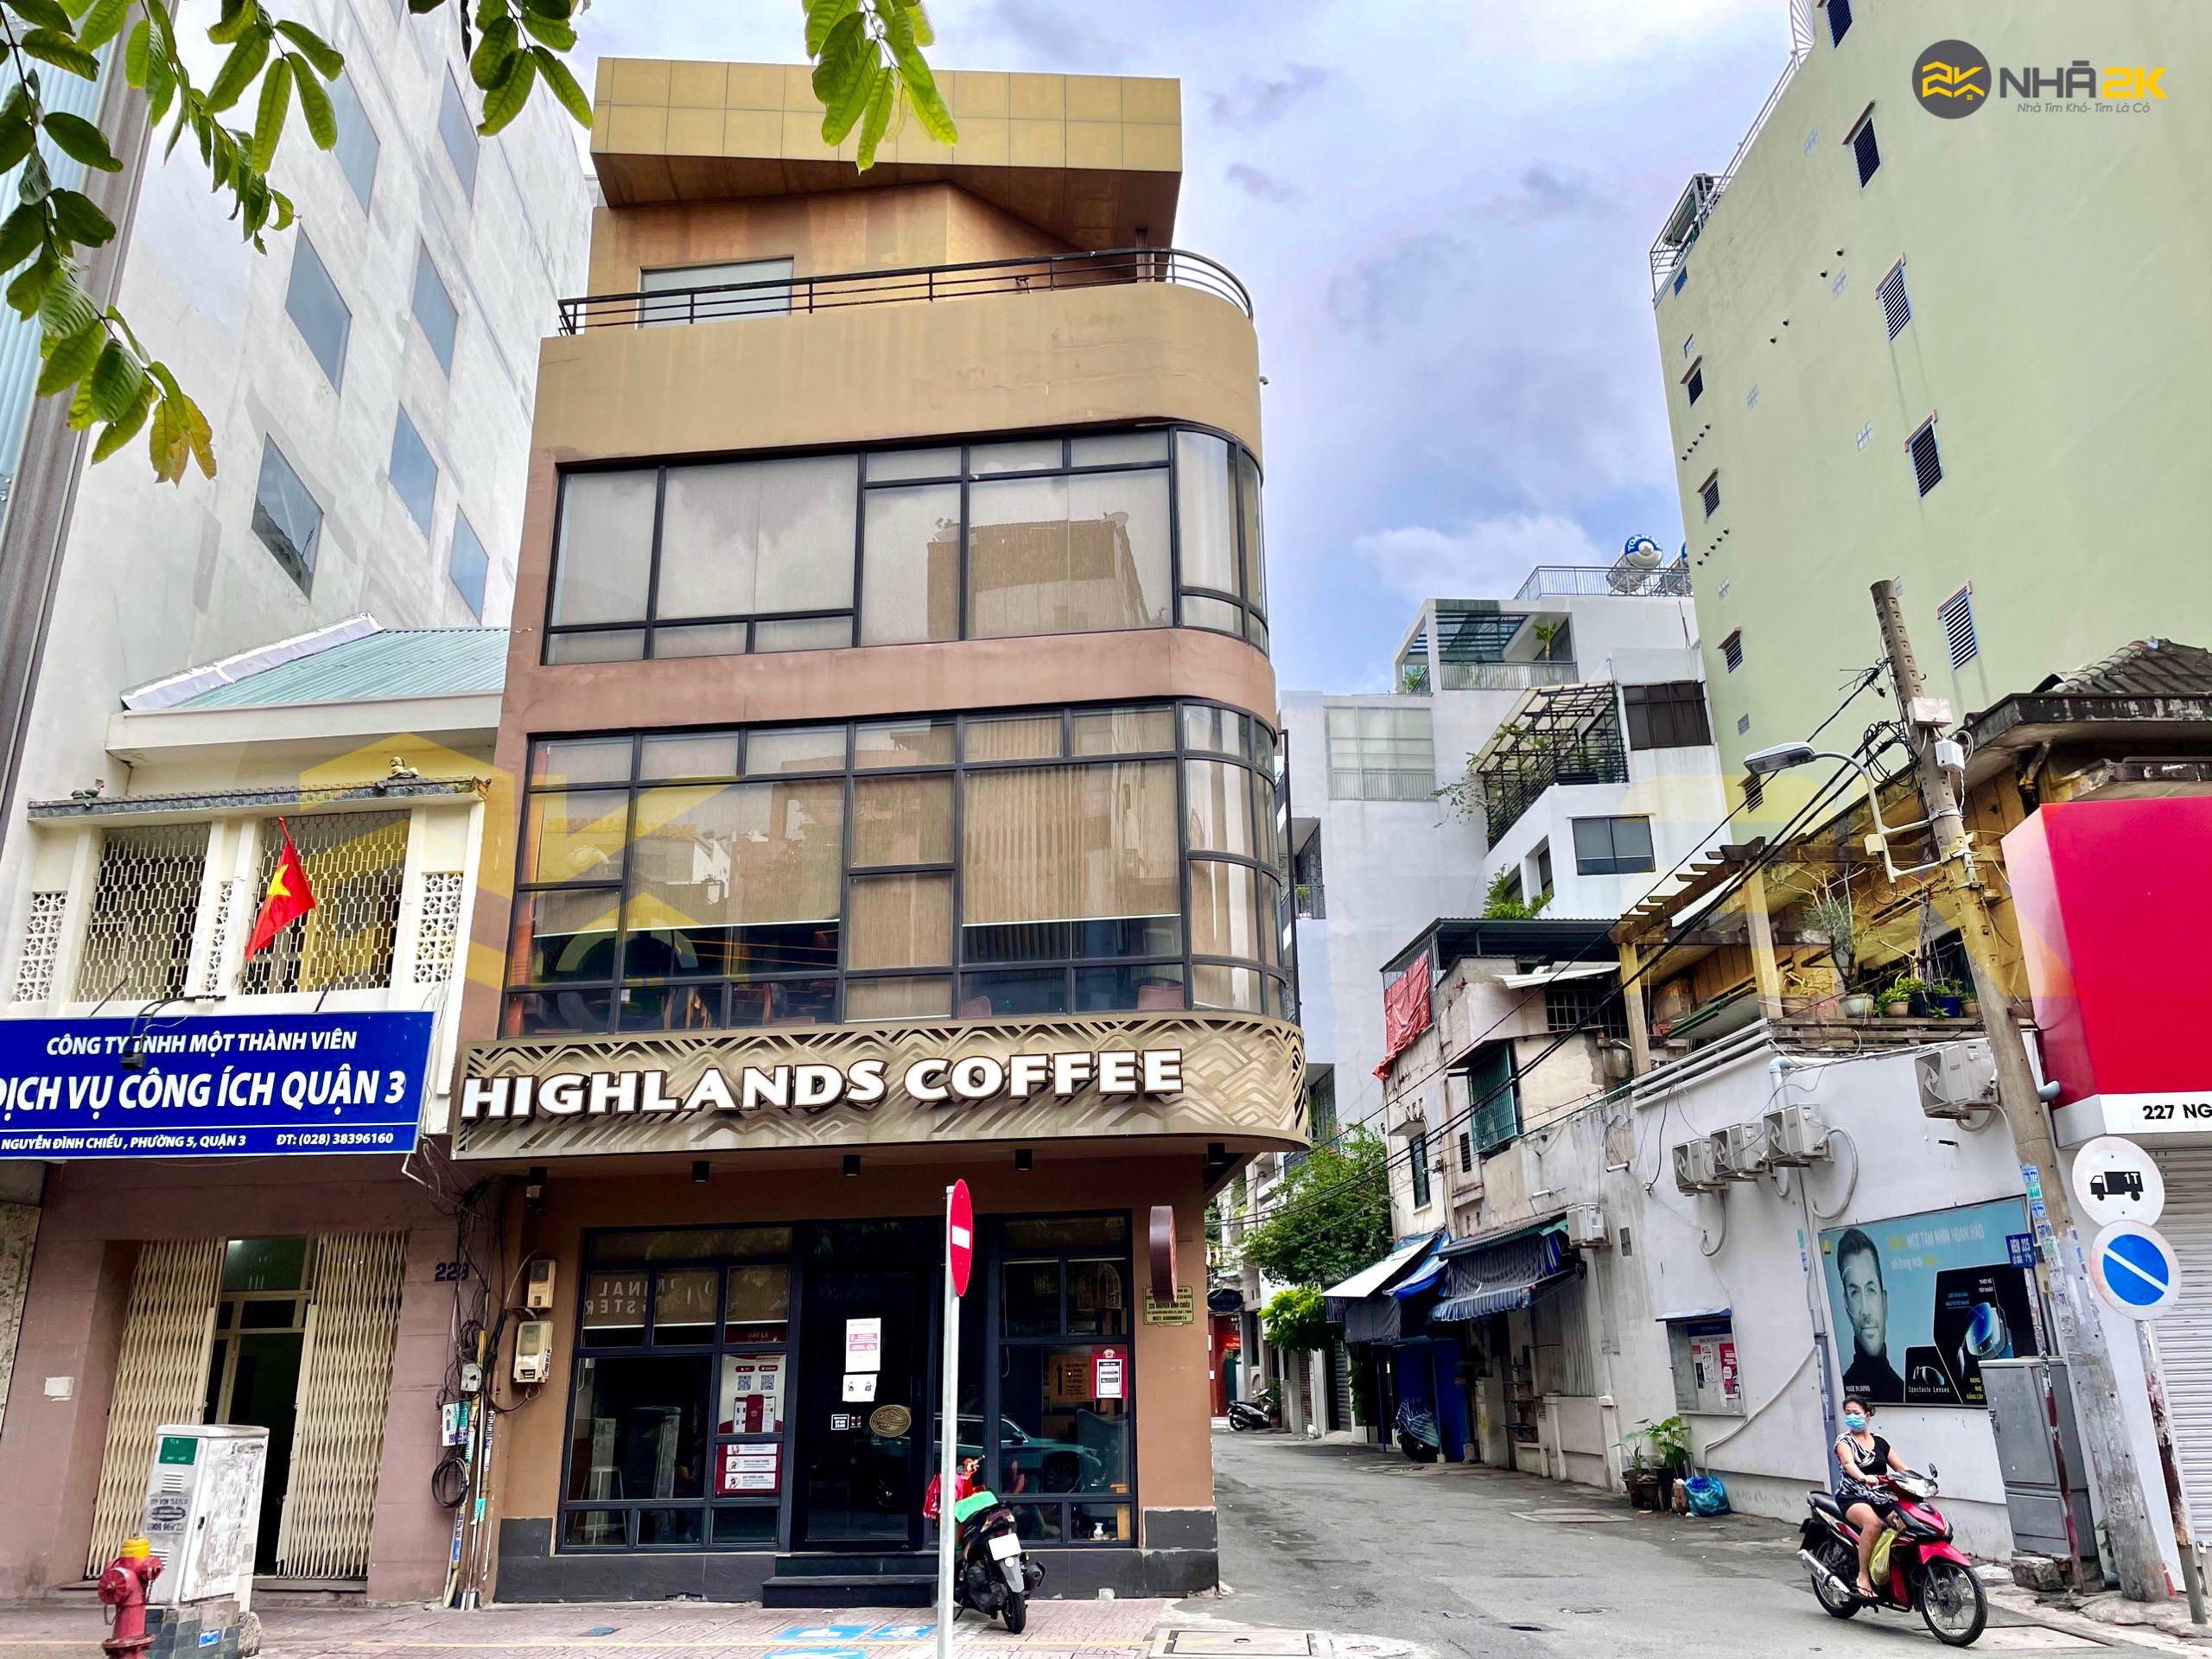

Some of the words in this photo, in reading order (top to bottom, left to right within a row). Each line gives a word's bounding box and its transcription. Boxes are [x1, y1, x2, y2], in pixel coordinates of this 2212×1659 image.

[47, 1033, 101, 1055] CÔNG
[105, 1036, 129, 1054] TY
[132, 1035, 187, 1053] TNHH
[189, 1030, 235, 1058] MỘT
[238, 1030, 309, 1052] THÀNH
[310, 1027, 357, 1049] VIÊN
[68, 1076, 113, 1120] VỤ
[118, 1068, 212, 1109] CÔNG
[217, 1065, 276, 1107] ÍCH
[282, 1063, 378, 1116] QUẬN
[385, 1071, 405, 1103] 3
[460, 1060, 885, 1121] HIGHLANDS
[904, 1049, 1185, 1103] COFFEE
[2143, 1105, 2174, 1120] 227
[1, 1135, 51, 1149] NGUYỄN
[53, 1136, 85, 1149] ĐÌNH
[130, 1135, 184, 1147] PHƯỜNG
[186, 1136, 197, 1148] 5,
[200, 1134, 236, 1149] QUẬN
[238, 1135, 246, 1146] 3
[276, 1134, 296, 1145] ĐT:
[299, 1134, 330, 1146] (028)
[333, 1133, 393, 1145] 38396160
[2124, 1173, 2139, 1185] 1T
